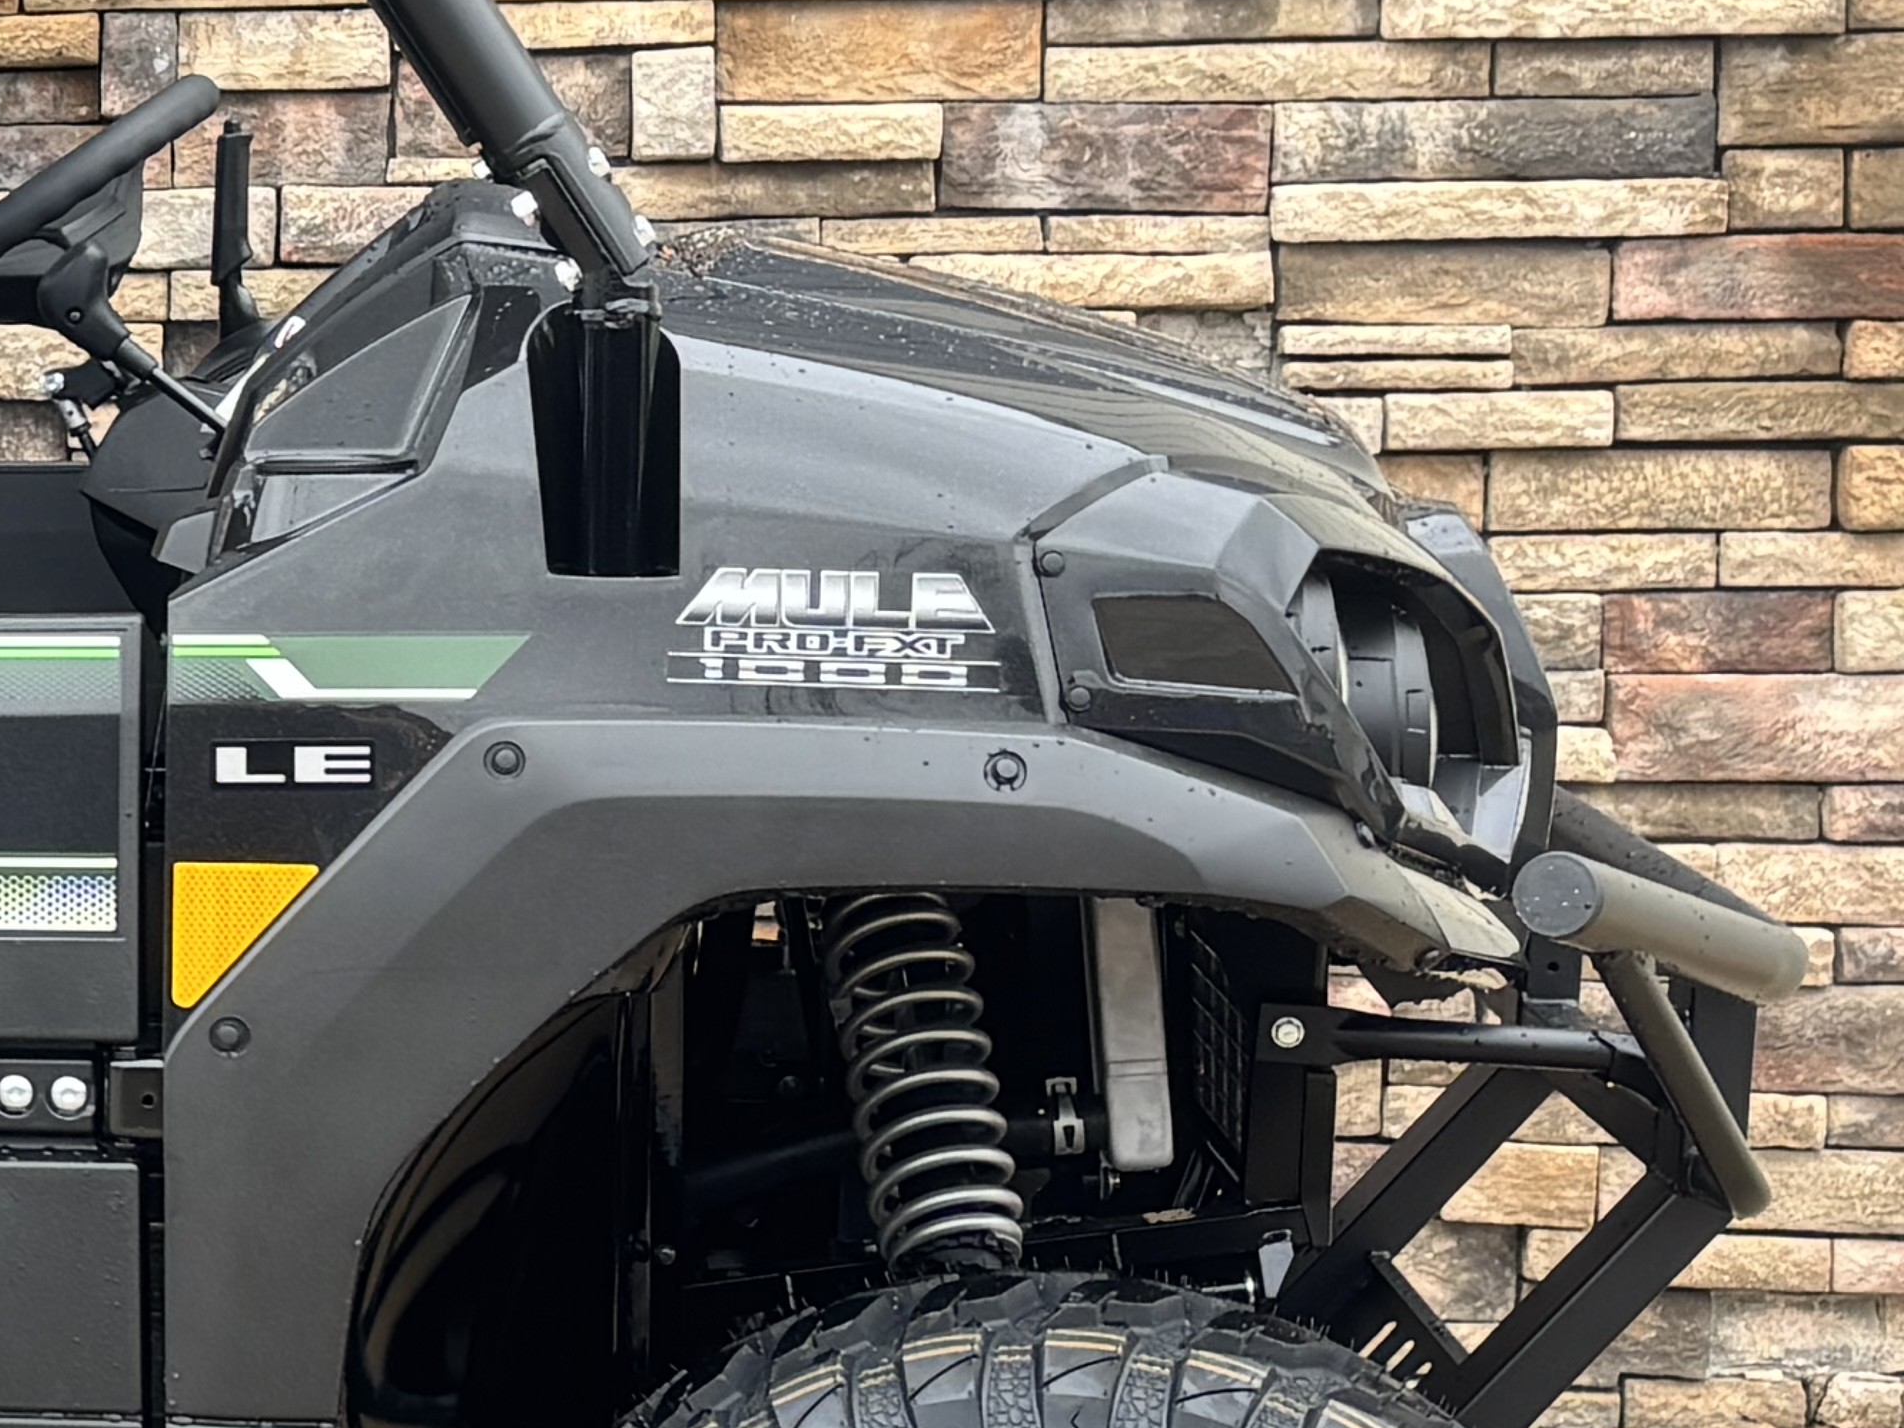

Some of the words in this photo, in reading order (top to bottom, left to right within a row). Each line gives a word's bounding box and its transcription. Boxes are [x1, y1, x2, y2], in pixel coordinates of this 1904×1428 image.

[675, 567, 995, 634] MULE
[703, 625, 966, 659] PRO-FXT
[699, 657, 968, 687] 1000
[215, 745, 372, 784] LE
